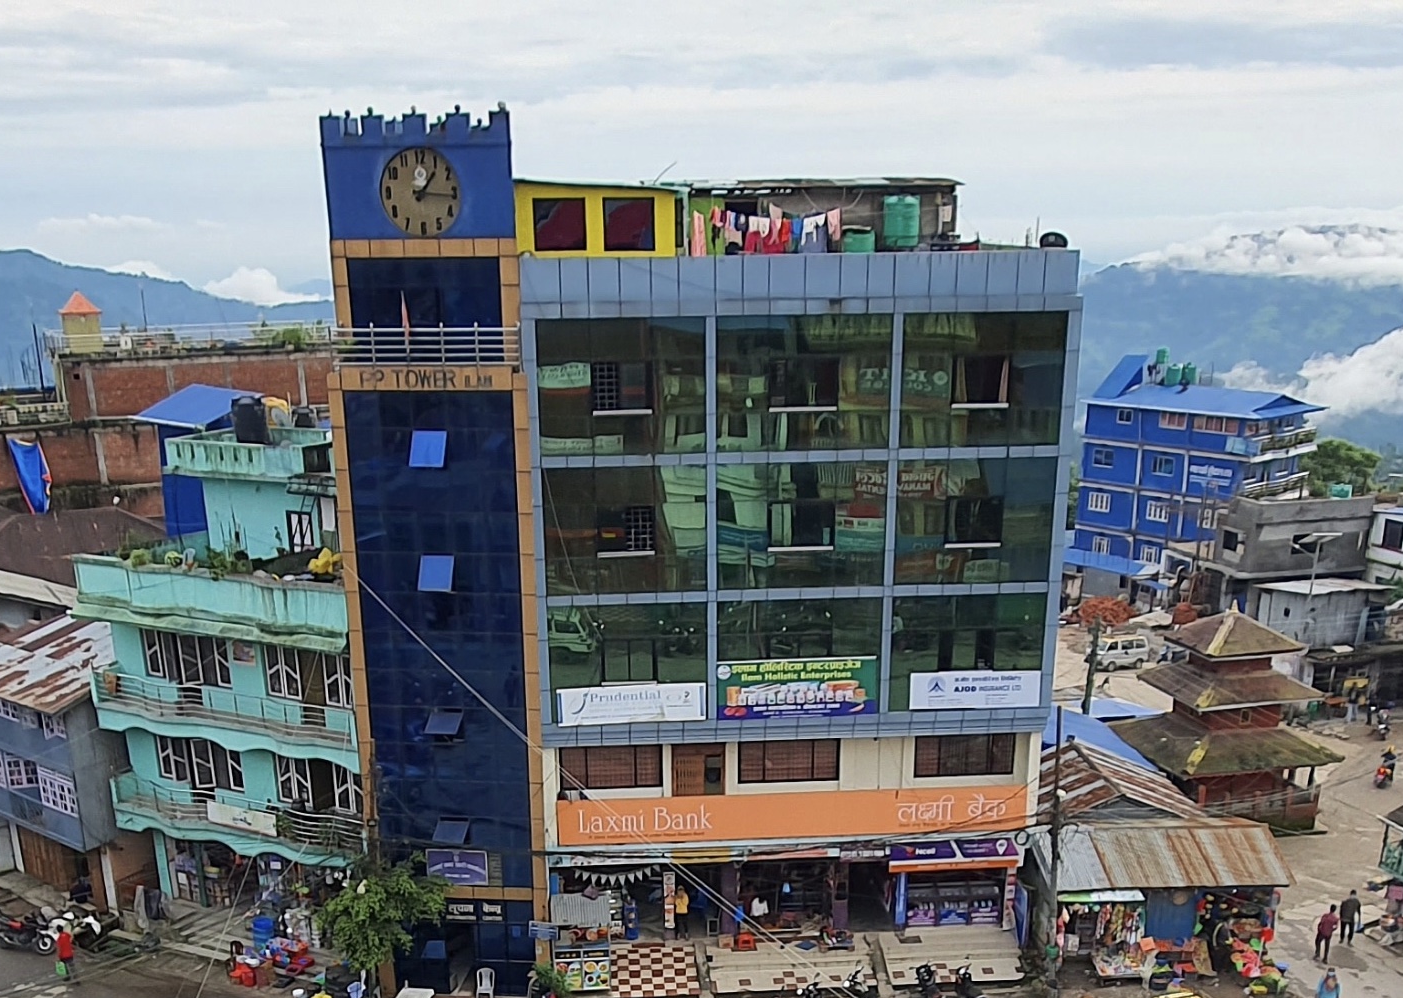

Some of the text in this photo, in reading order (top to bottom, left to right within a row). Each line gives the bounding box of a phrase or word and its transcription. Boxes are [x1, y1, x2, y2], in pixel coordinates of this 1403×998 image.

[400, 153, 408, 168] 11
[414, 149, 426, 165] 12
[388, 166, 398, 180] 10
[391, 369, 457, 389] TOWER
[764, 671, 798, 681] Holistic
[800, 670, 852, 680] Enterprises
[953, 685, 977, 693] AJOD
[590, 690, 661, 703] Prudential
[578, 803, 713, 833] Laxmi Bank
